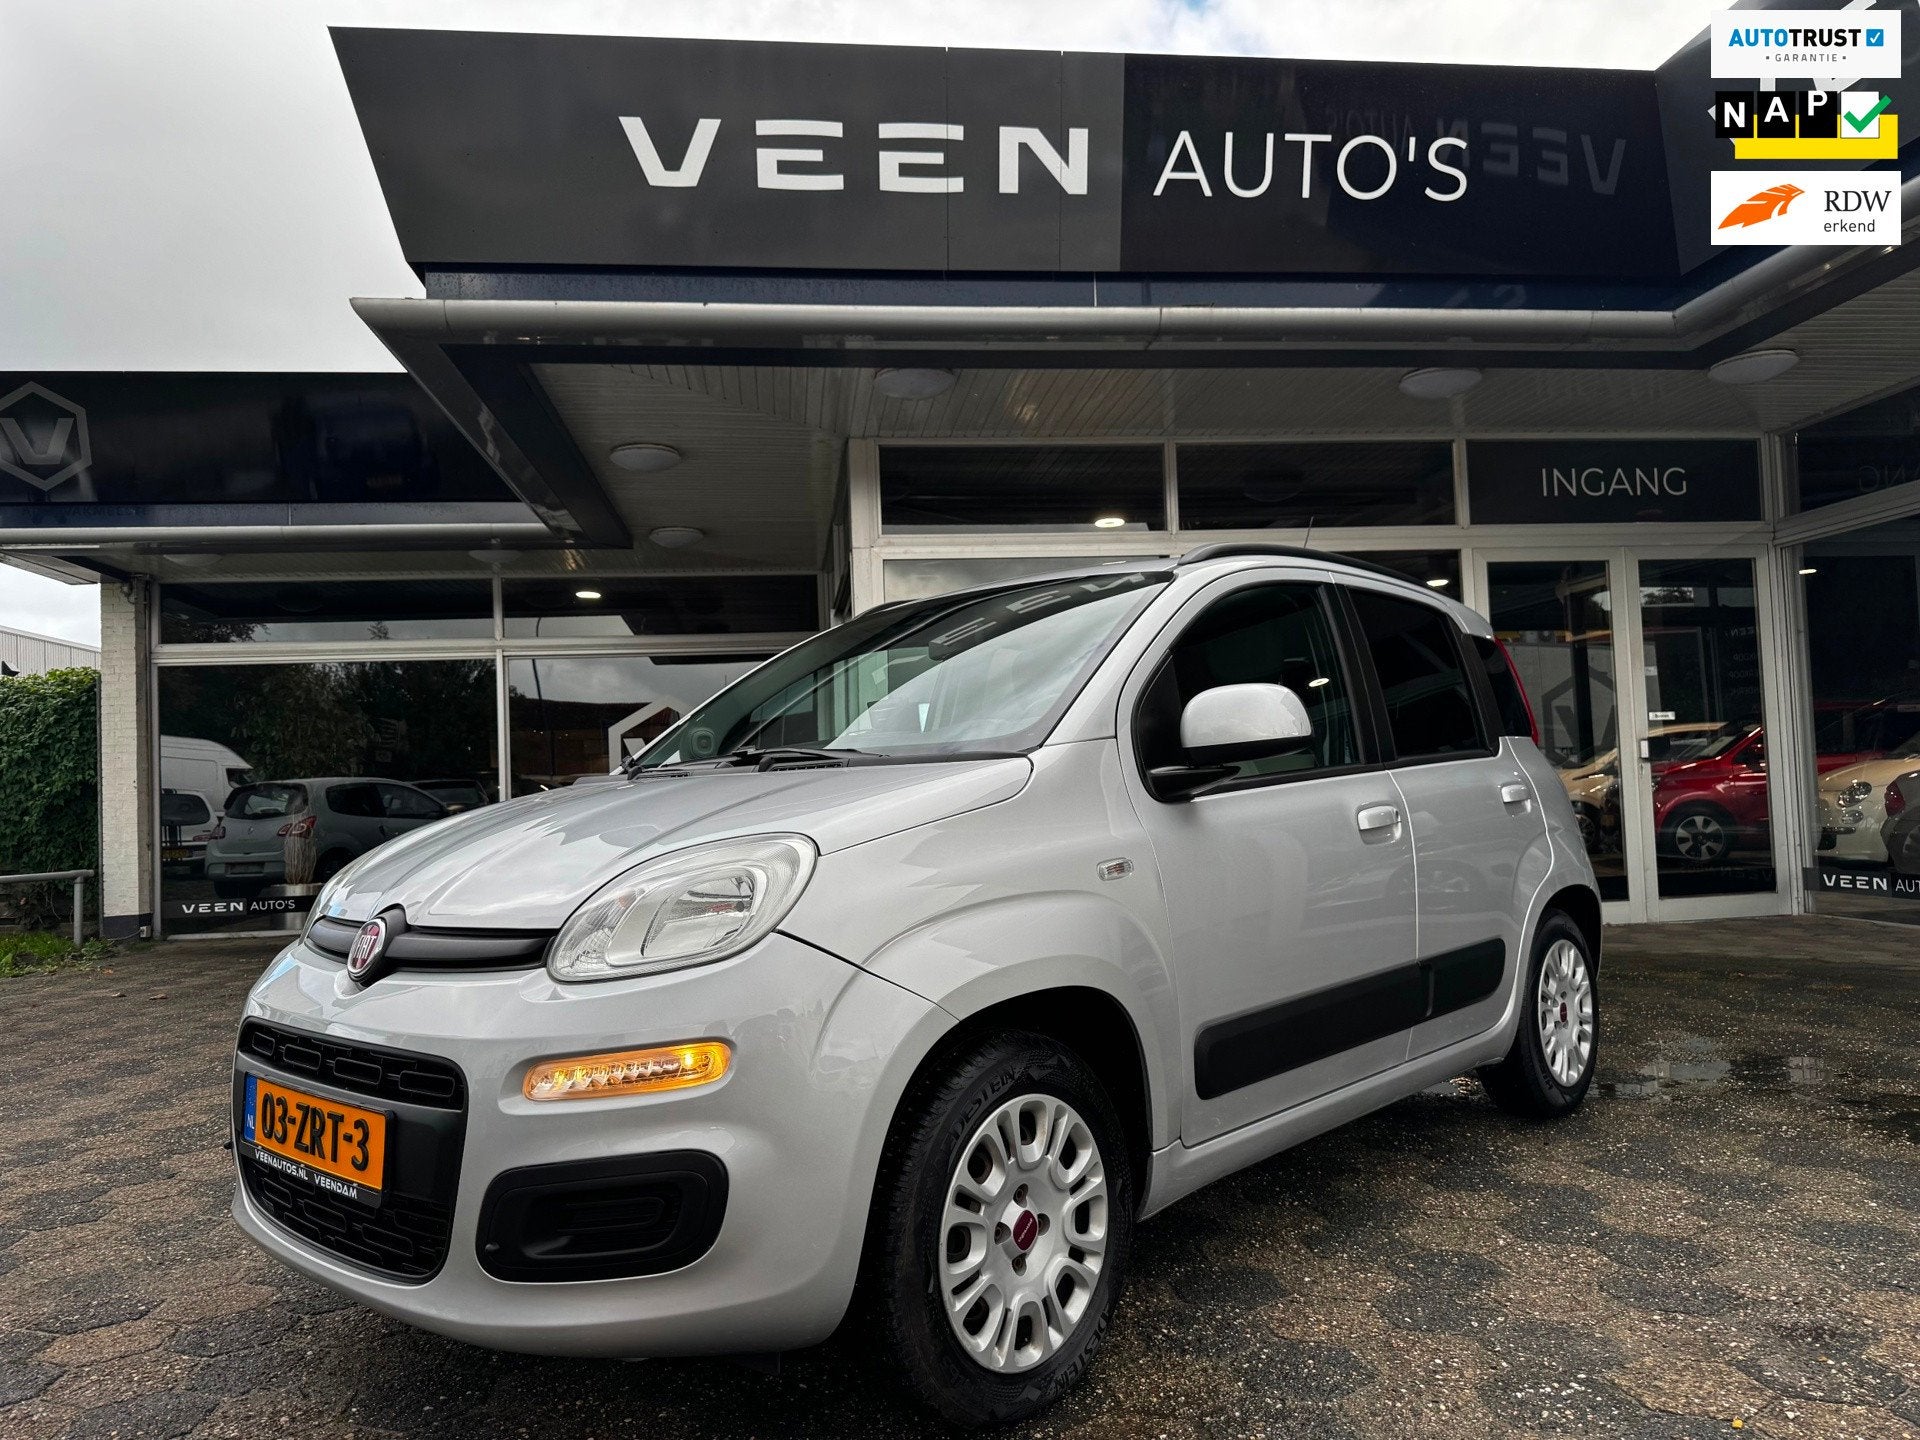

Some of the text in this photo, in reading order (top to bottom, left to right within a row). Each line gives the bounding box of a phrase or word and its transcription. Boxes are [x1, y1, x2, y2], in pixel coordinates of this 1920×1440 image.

[618, 115, 1469, 202] VEEN AUTO'S
[1541, 466, 1689, 498] INGANG
[1822, 873, 1888, 891] VEEN
[181, 899, 296, 914] VEEN AUTO'S
[246, 1113, 255, 1130] NL
[261, 1091, 370, 1172] 03-ZRT-3
[254, 1148, 358, 1200] VEENAUTOS.NL VEENDAM
